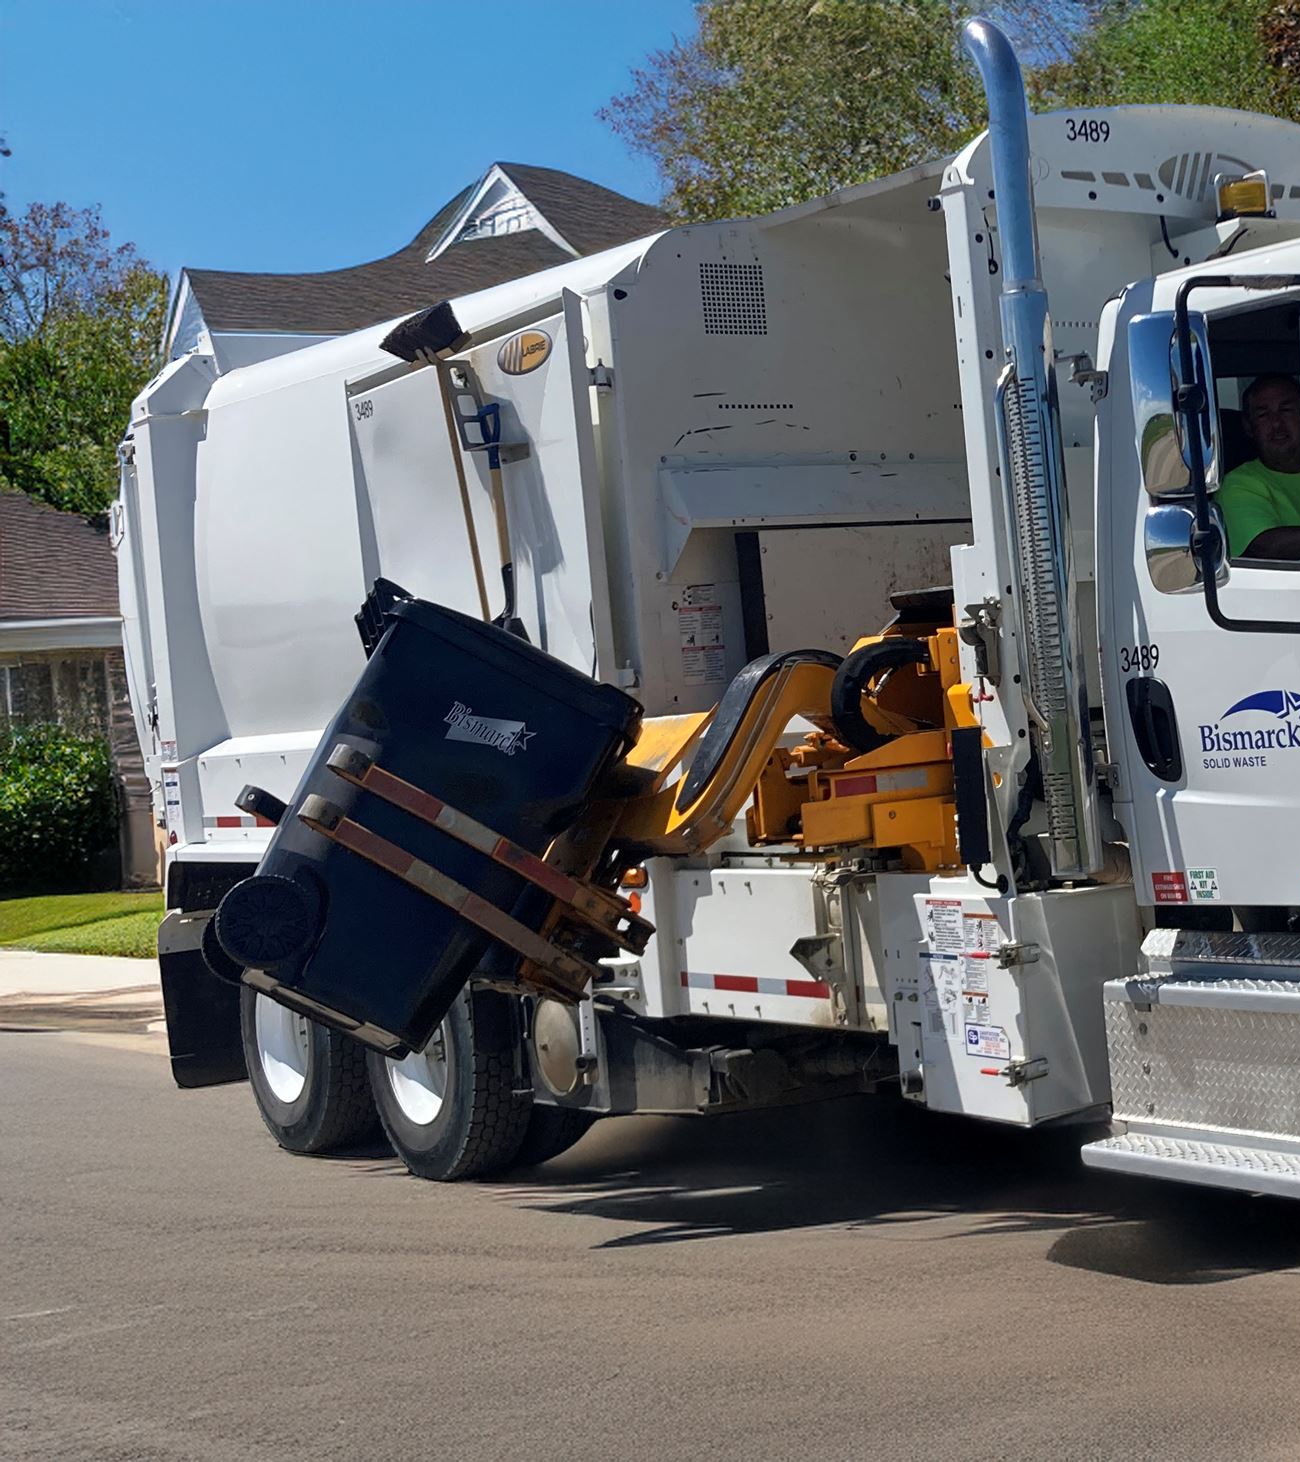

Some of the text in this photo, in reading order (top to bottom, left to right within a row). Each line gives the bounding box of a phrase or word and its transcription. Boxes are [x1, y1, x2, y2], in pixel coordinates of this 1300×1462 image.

[1066, 118, 1110, 143] 3489
[354, 399, 373, 421] 3489
[1120, 644, 1160, 673] 3489
[443, 700, 521, 756] Bismarck
[1203, 756, 1267, 770] SOLID WASTE
[1190, 870, 1215, 879] FIRST AID
[1199, 880, 1208, 889] KIT
[1196, 890, 1215, 899] INSIDE
